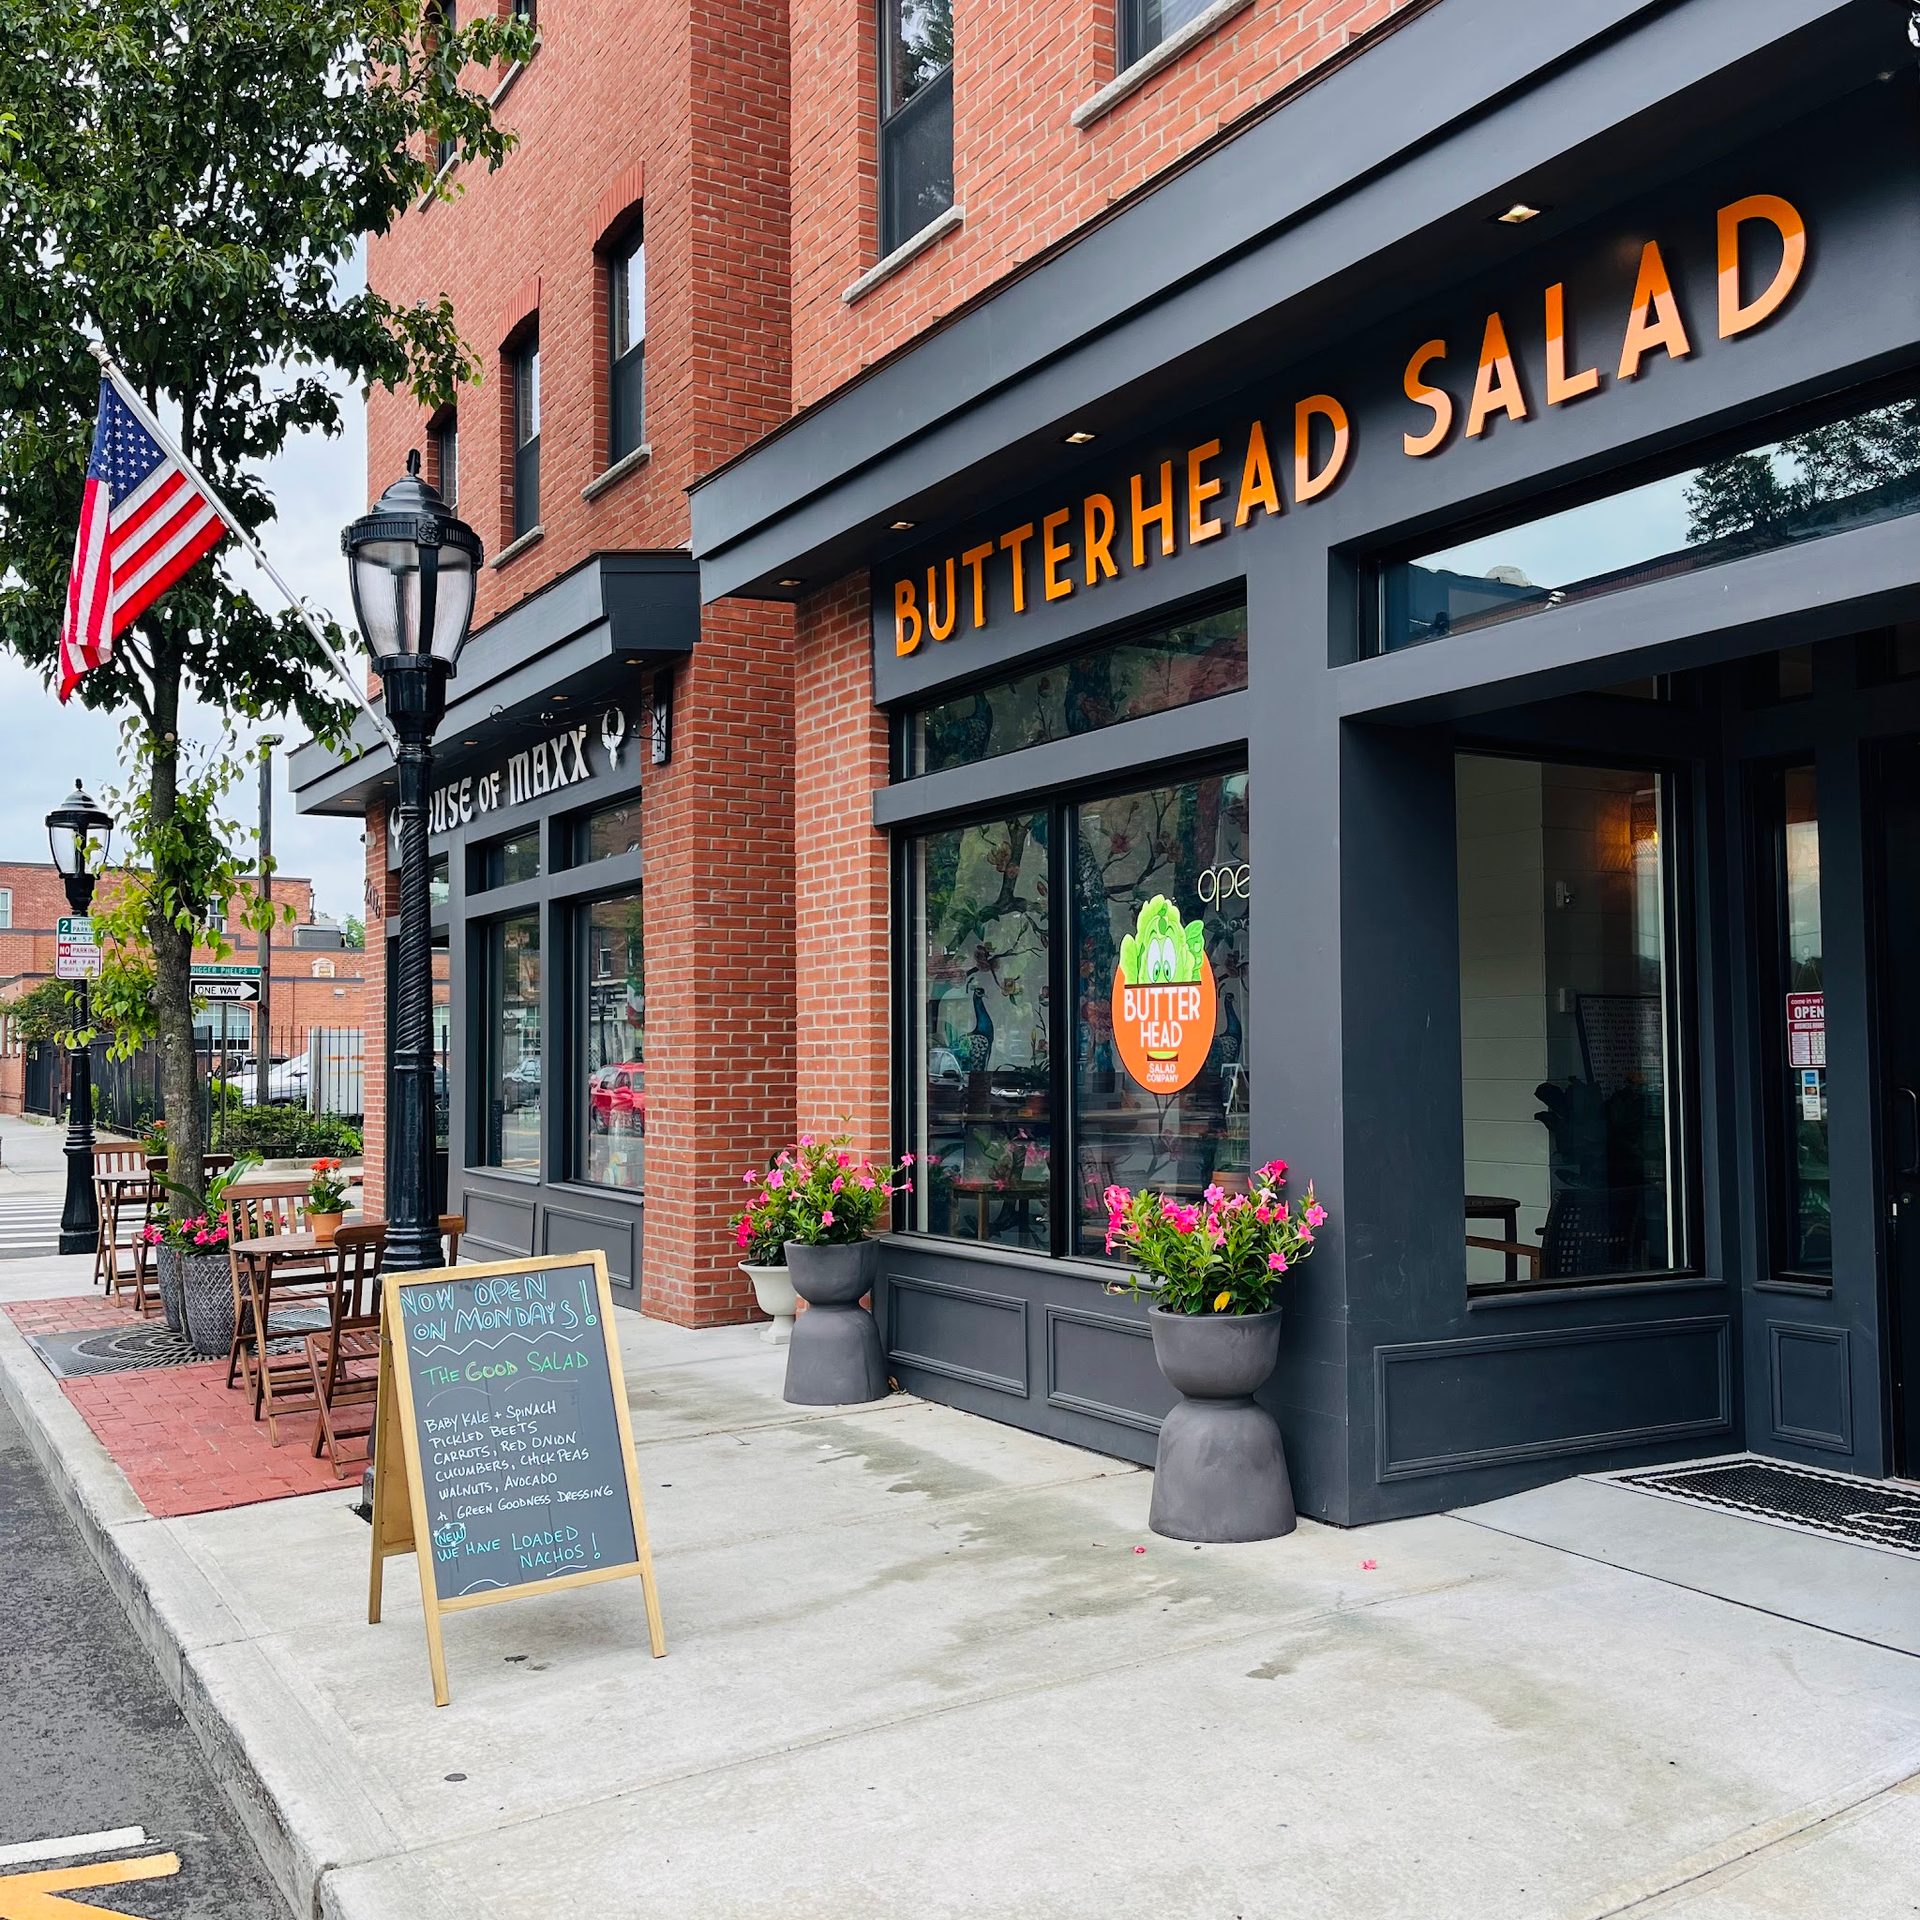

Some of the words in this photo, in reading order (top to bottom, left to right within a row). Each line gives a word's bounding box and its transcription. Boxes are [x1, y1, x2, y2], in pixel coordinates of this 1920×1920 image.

[895, 394, 1349, 657] BUTTERHEAD
[1402, 194, 1807, 457] SALAD
[427, 776, 473, 835] USE
[478, 770, 500, 813] OF
[507, 723, 590, 806] MAXX
[61, 920, 69, 932] 2
[60, 945, 70, 955] NO
[190, 966, 217, 974] DIGGER
[220, 966, 248, 975] PHELPS
[197, 986, 217, 995] ONE
[219, 986, 239, 995] WAY
[1124, 986, 1201, 1022] BUTTER
[1794, 1005, 1825, 1019] OPEN
[1140, 1020, 1183, 1049] HEAD
[1146, 1073, 1179, 1083] COMPANY
[1149, 1063, 1176, 1074] SALAD
[400, 1285, 454, 1318] NOW
[474, 1273, 547, 1306] OPEN
[413, 1318, 447, 1342] ON
[420, 1365, 461, 1386] THE
[464, 1361, 519, 1382] GOOD
[526, 1351, 589, 1373] SALAD
[424, 1414, 459, 1434] BABY
[461, 1410, 490, 1428] KALE
[428, 1430, 484, 1449] PICKLED
[488, 1421, 539, 1438] BEETS
[433, 1445, 498, 1466] CARROTS,
[500, 1439, 528, 1453] RED
[531, 1431, 578, 1449] ONION
[435, 1459, 516, 1483] CUCUMBERS,
[504, 1472, 559, 1491] AVOCADO
[456, 1502, 494, 1520] GREEN
[497, 1494, 551, 1512] GOODNESS
[556, 1485, 614, 1503] DRESSING
[437, 1545, 460, 1563] WE
[465, 1538, 501, 1556] HAVE
[511, 1525, 579, 1551] LOADED
[438, 1530, 465, 1545] NEW
